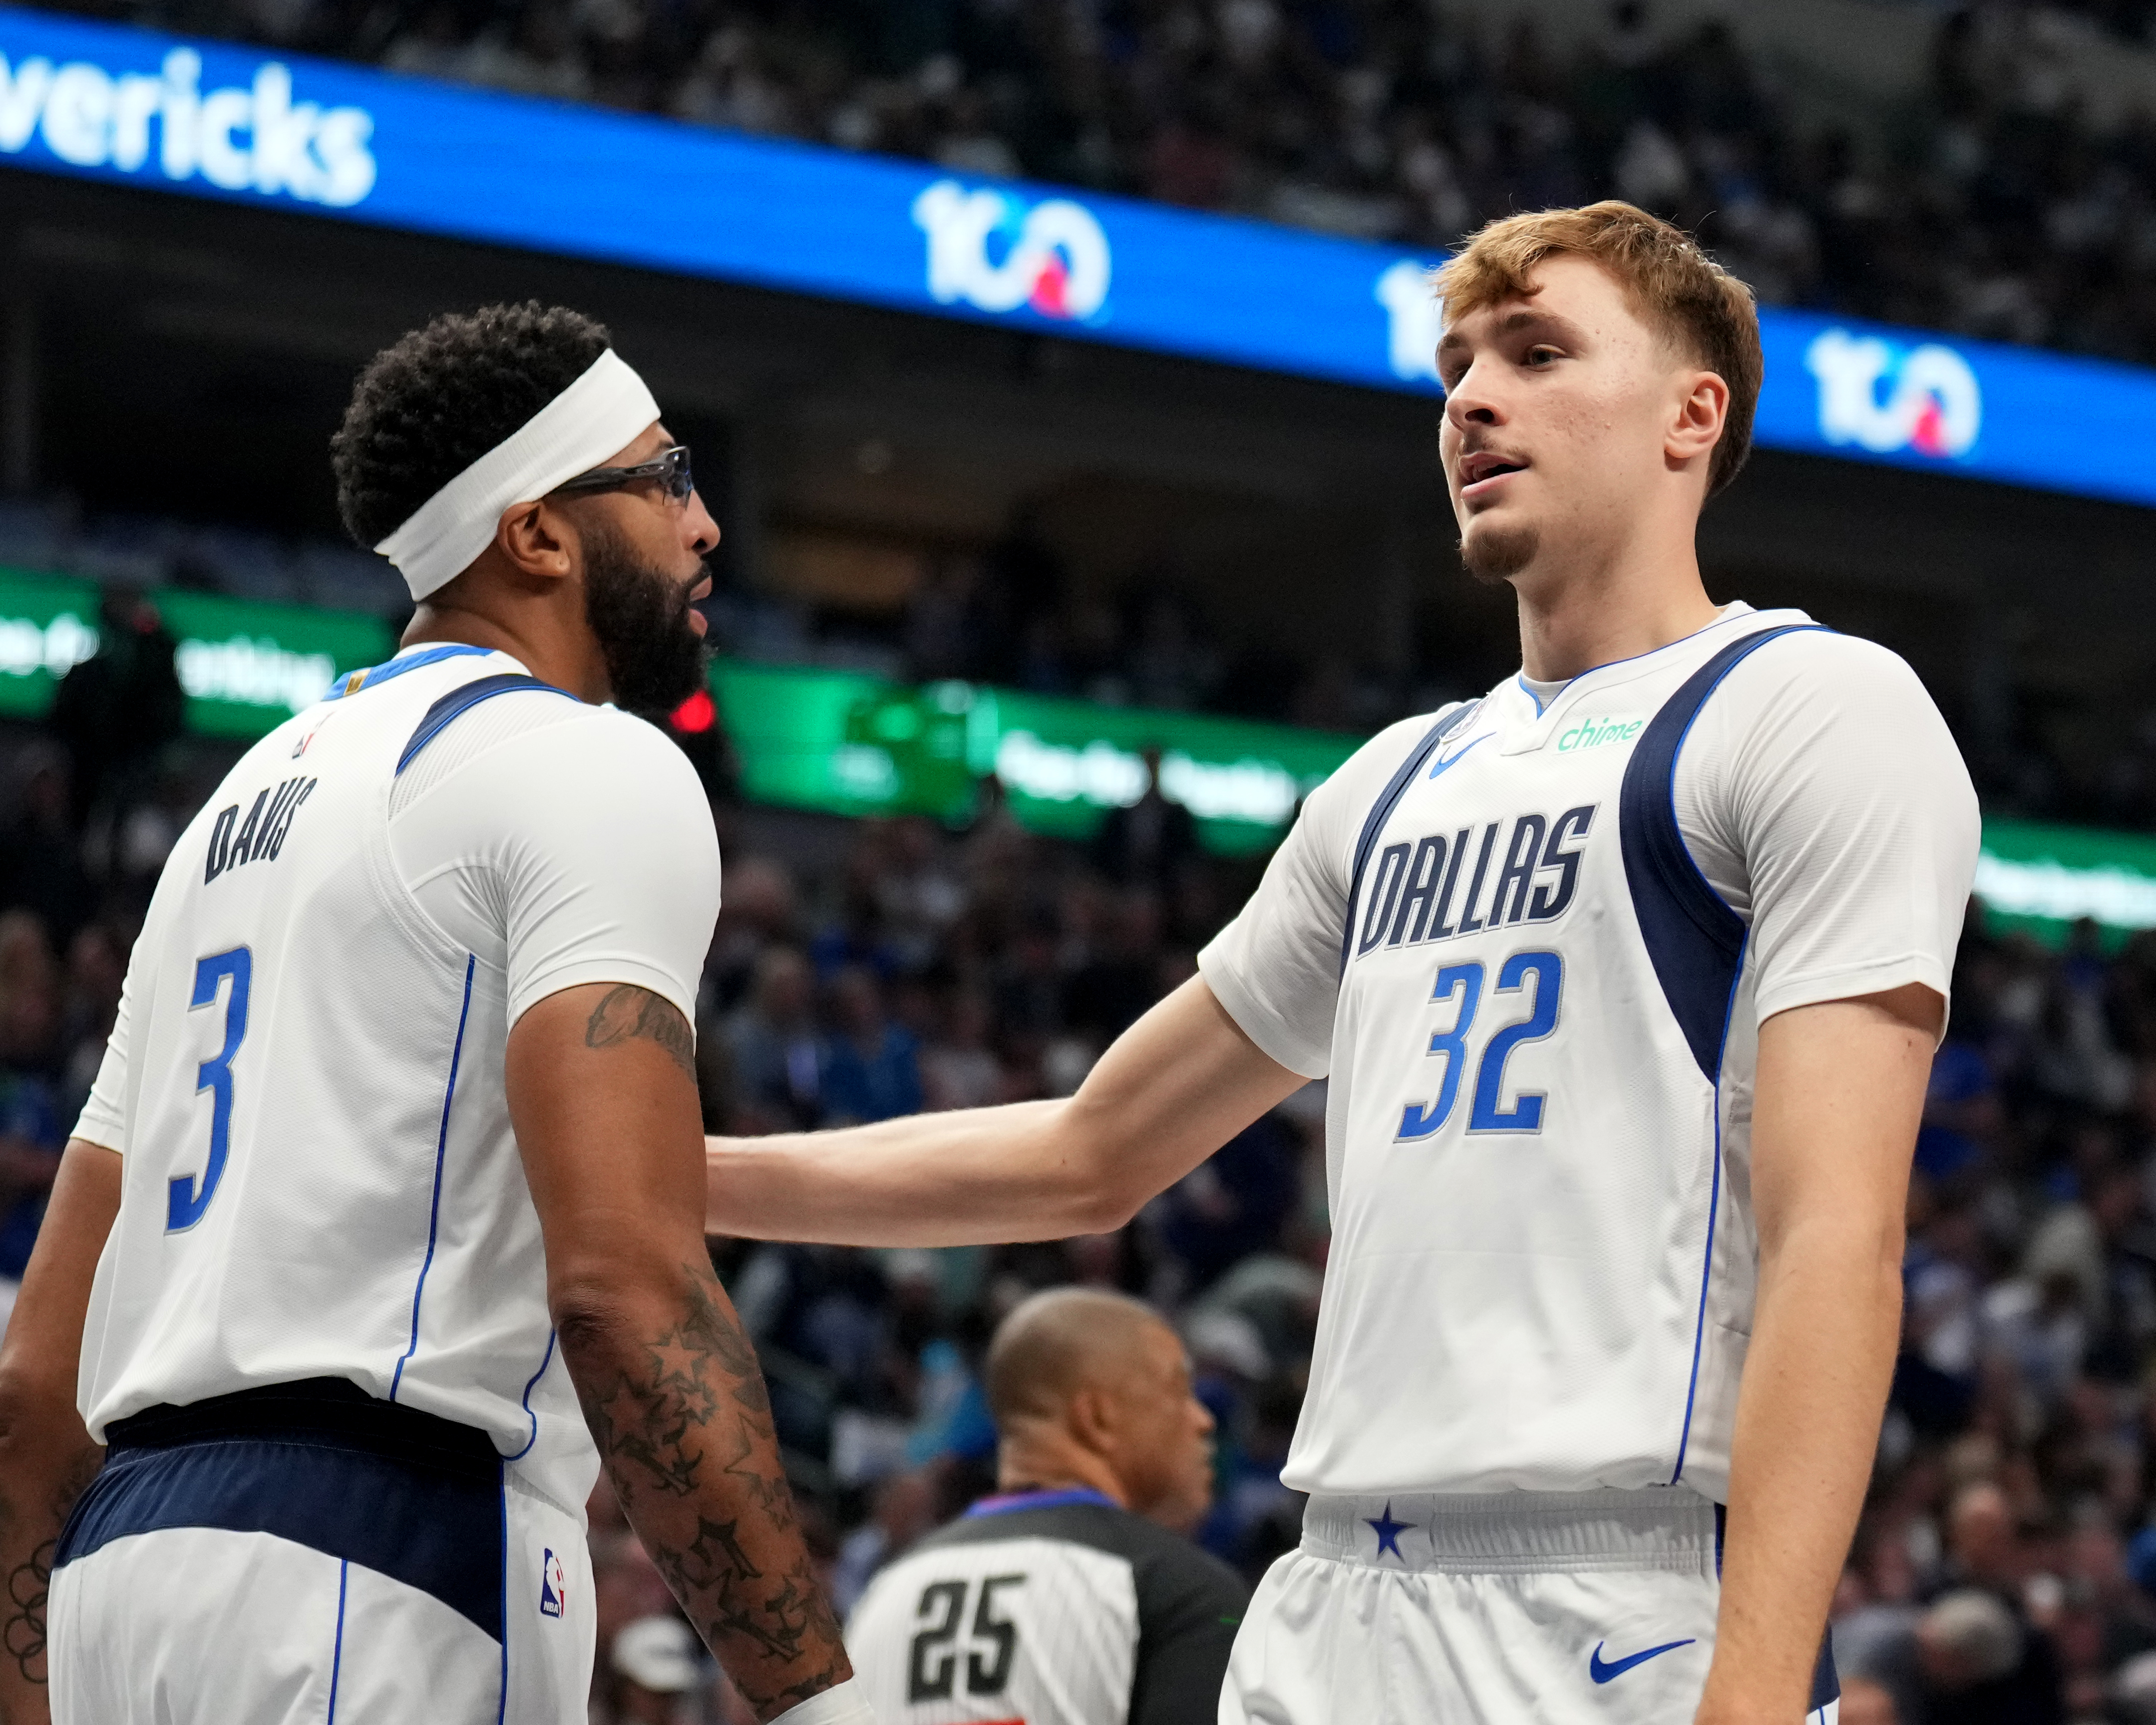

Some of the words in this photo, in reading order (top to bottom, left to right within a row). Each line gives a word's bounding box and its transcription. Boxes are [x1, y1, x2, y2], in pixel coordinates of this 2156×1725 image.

[1558, 717, 1643, 751] chime
[204, 776, 318, 886] DAVIS
[1355, 801, 1601, 962] DALLAS
[164, 943, 253, 1236] 3
[1393, 946, 1566, 1144] 32
[543, 1601, 559, 1614] NBA
[910, 1572, 1030, 1703] 25
